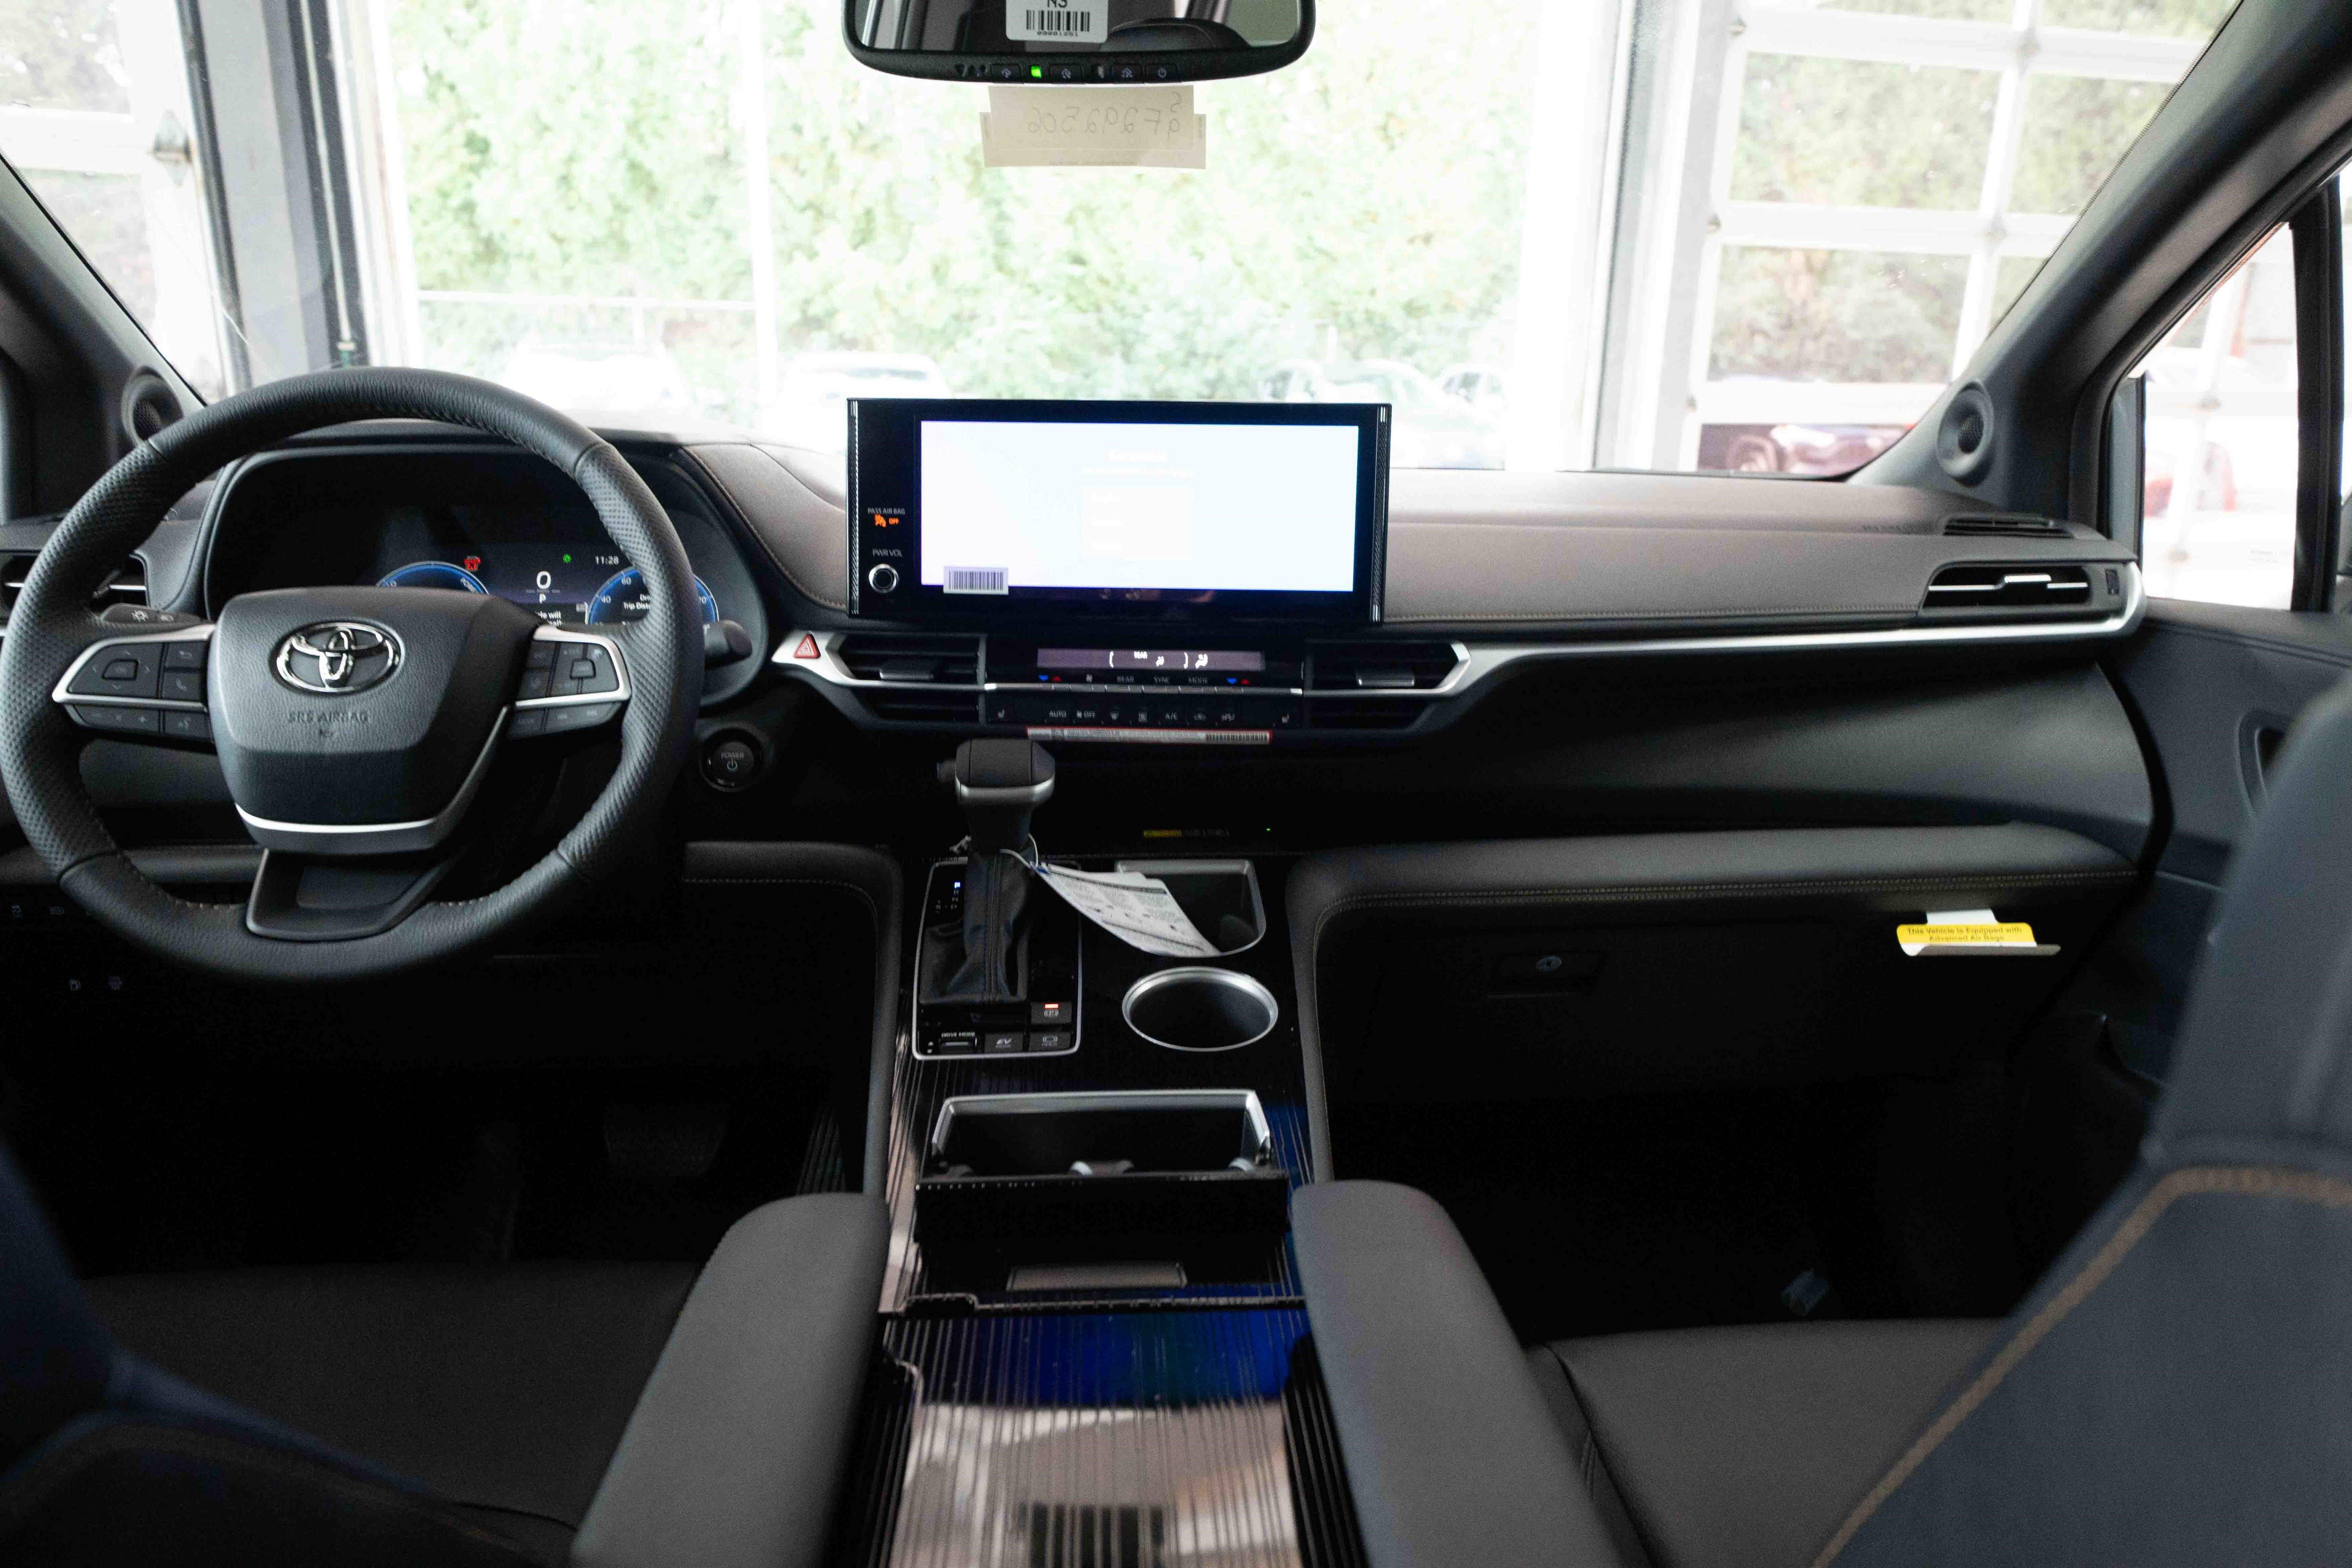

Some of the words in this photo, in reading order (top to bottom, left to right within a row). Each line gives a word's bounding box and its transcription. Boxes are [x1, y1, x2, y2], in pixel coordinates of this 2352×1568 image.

[873, 548, 889, 557] PWR
[889, 548, 903, 557] VOL
[536, 571, 551, 589] 0
[539, 594, 546, 604] P
[601, 595, 611, 604] 40
[623, 602, 635, 611] Trip
[1188, 677, 1209, 685] MODE
[288, 710, 314, 723] SRS
[317, 710, 368, 725] AIRBAG
[1049, 710, 1067, 719] AUTO
[721, 751, 744, 760] POWER
[1966, 927, 2003, 935] Equipped
